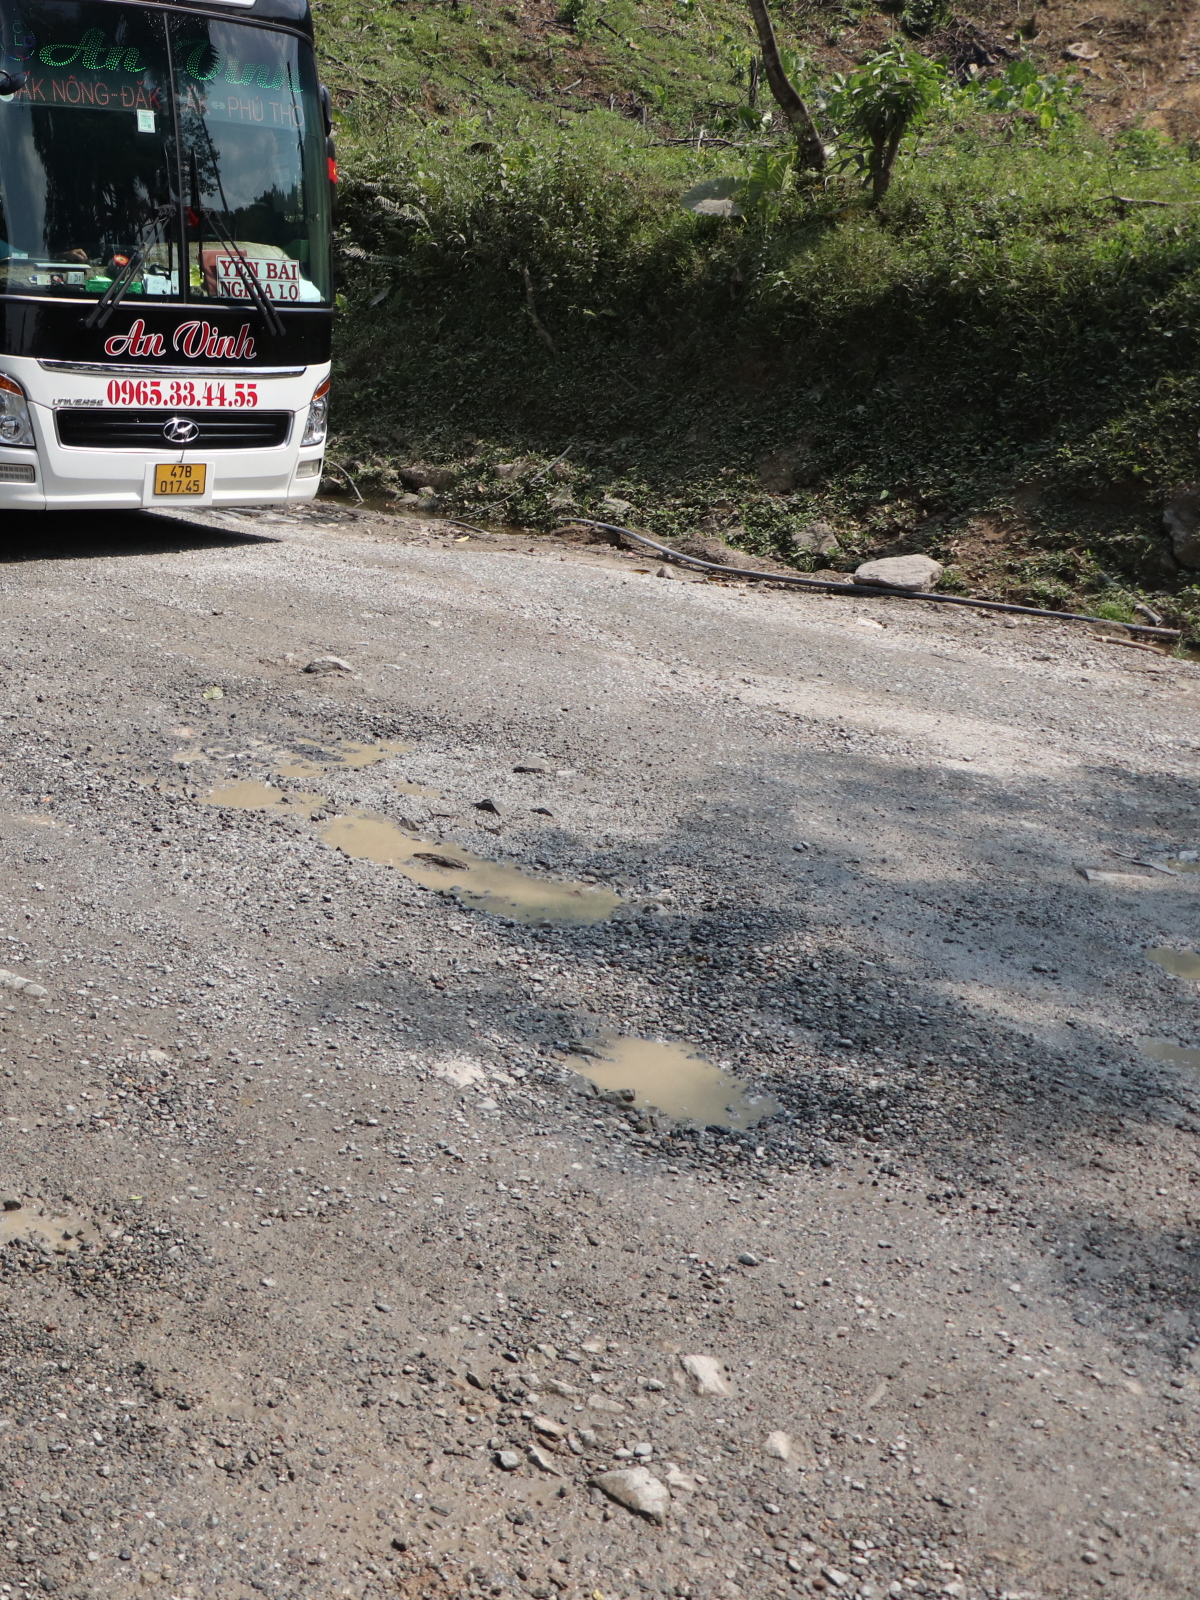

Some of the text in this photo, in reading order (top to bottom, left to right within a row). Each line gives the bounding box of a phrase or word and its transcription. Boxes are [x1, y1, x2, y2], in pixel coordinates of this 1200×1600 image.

[39, 27, 146, 72] An
[227, 96, 264, 122] PHÚ
[220, 281, 275, 299] NGHA
[104, 318, 257, 359] An Vinh
[107, 379, 258, 408] 0965.33.44.55
[171, 465, 192, 478] 47B
[160, 480, 200, 493] 017.45
